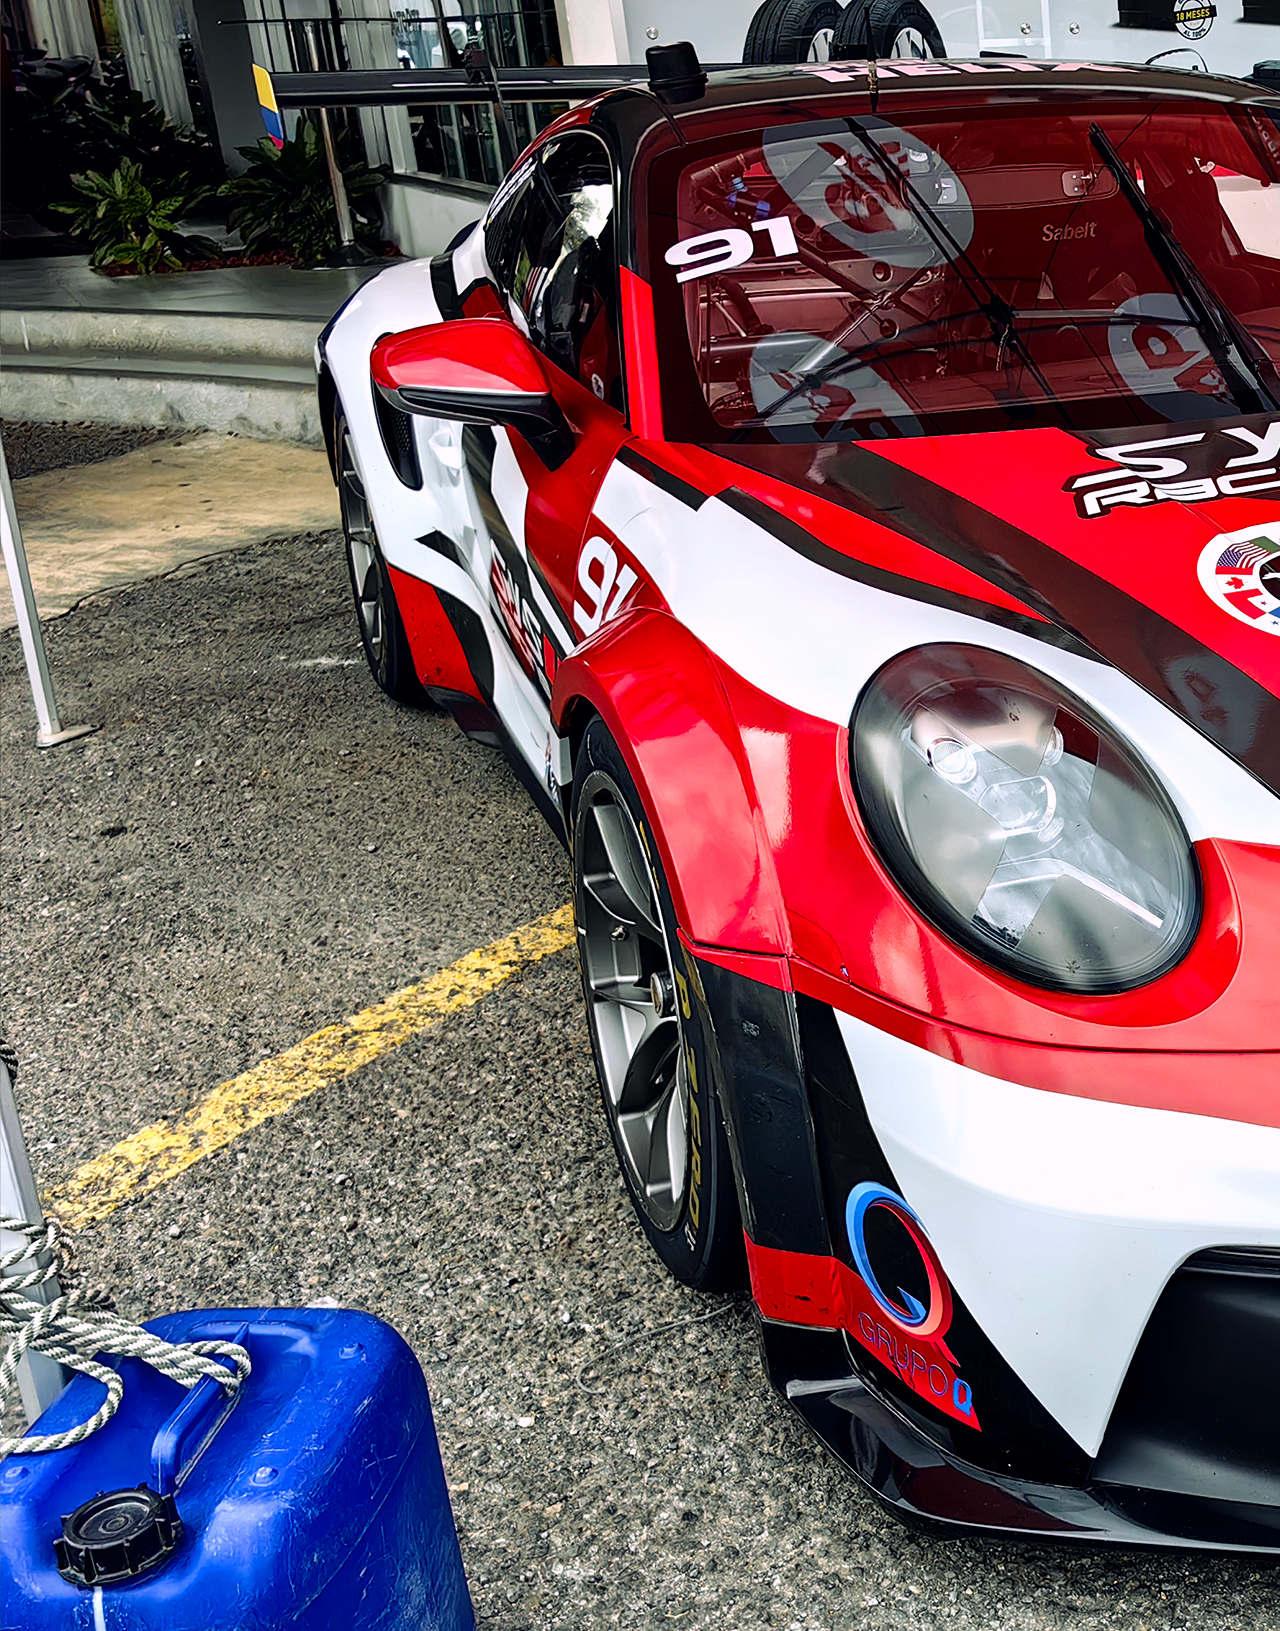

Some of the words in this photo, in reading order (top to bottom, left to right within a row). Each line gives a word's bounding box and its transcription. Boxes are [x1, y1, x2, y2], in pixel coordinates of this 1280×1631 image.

[1176, 12, 1185, 21] 18
[1186, 8, 1210, 20] MESES
[664, 216, 799, 283] 91
[1042, 222, 1097, 241] Sabelt
[574, 536, 639, 637] 91
[858, 1312, 949, 1396] GRUPO
[953, 1378, 973, 1416] Q
